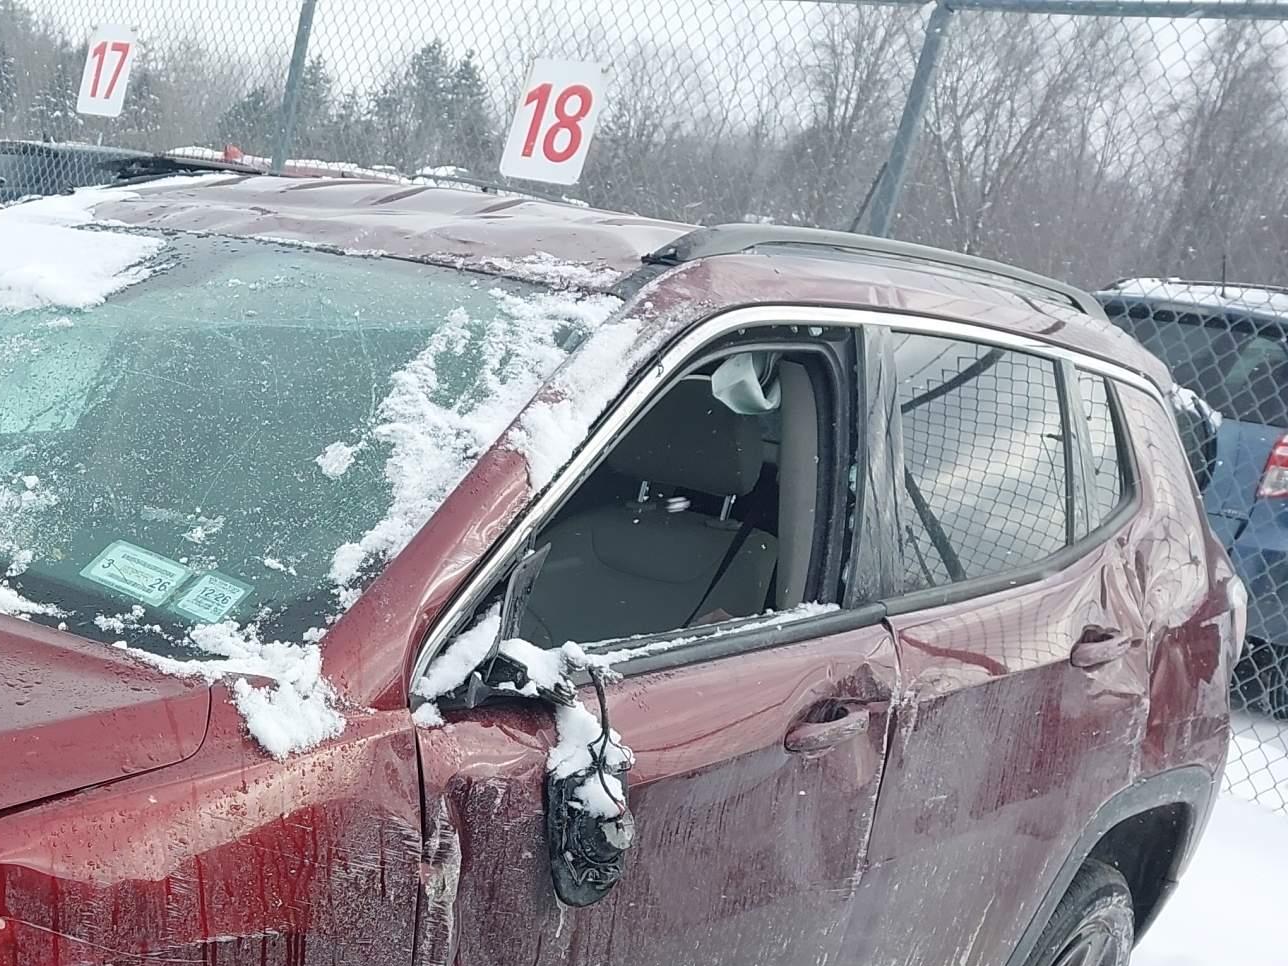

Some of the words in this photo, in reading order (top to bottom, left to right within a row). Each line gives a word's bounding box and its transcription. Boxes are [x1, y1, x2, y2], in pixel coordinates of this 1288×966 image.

[90, 41, 130, 99] 17
[521, 83, 593, 163] 18
[148, 577, 171, 592] 26
